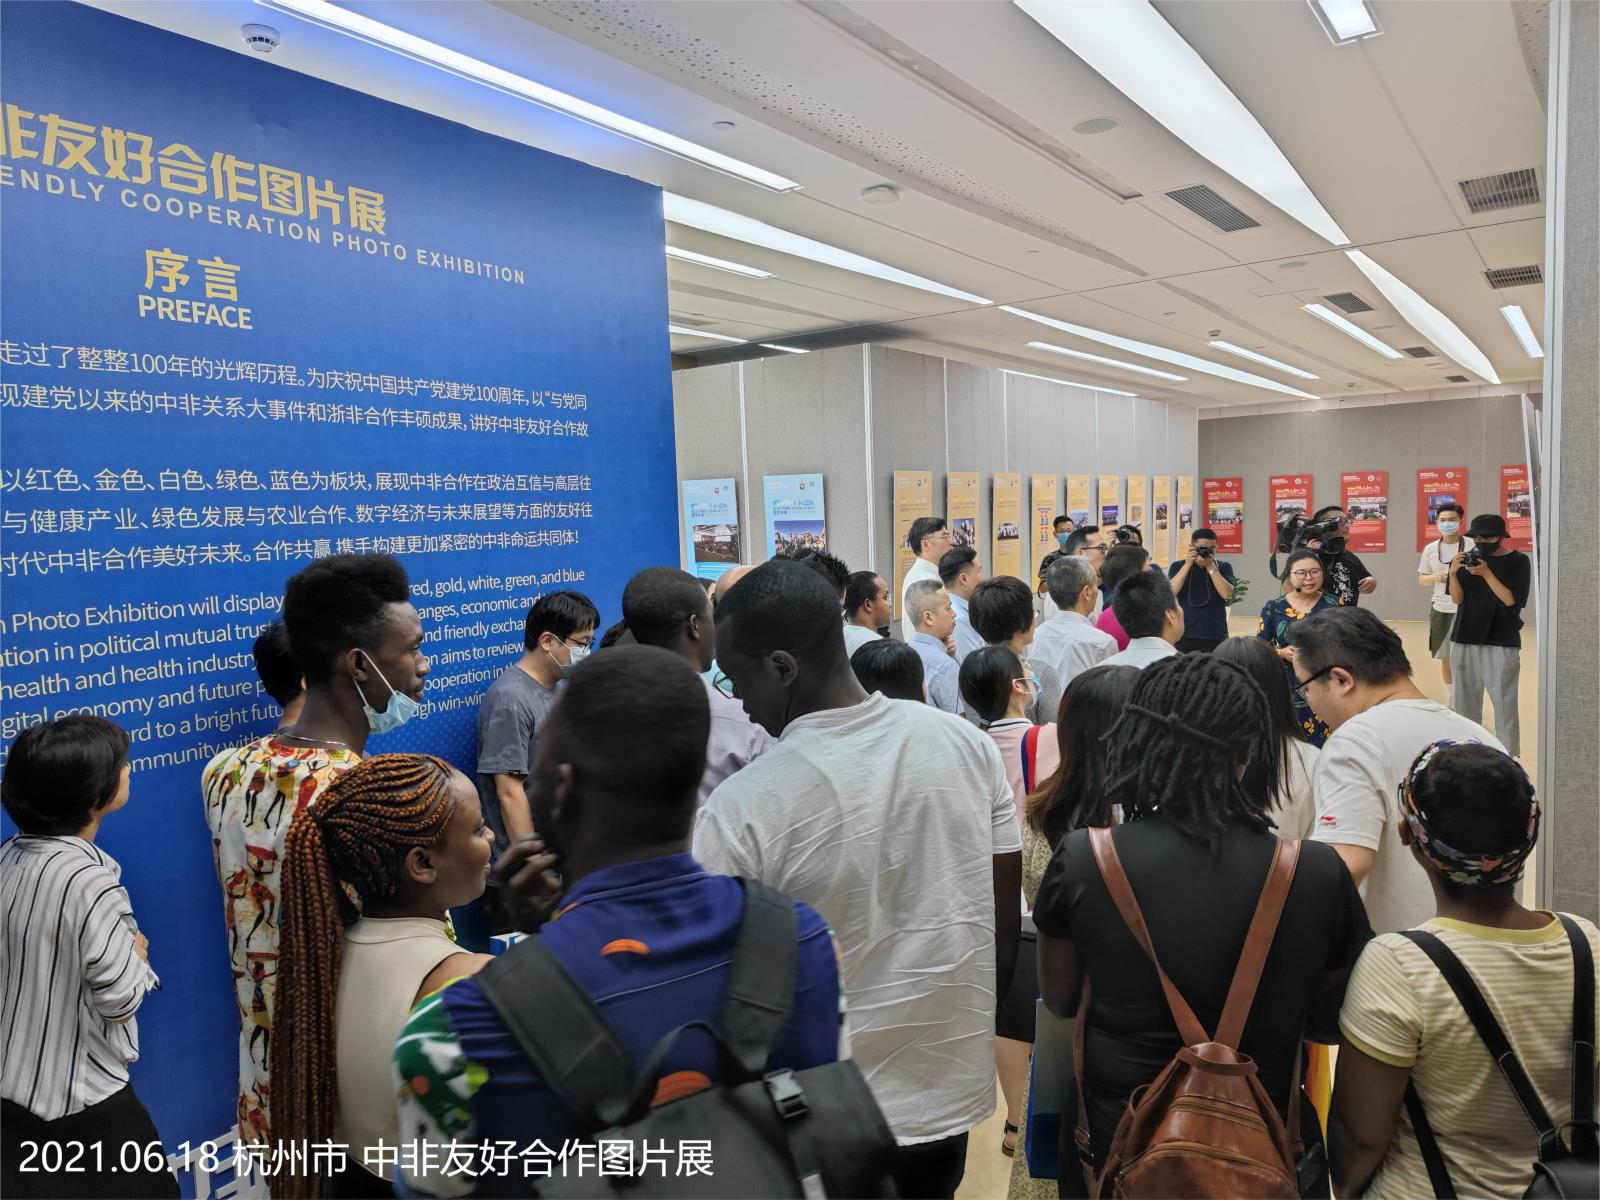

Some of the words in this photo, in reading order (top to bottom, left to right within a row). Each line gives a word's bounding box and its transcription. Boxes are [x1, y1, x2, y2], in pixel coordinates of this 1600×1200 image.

[120, 189, 321, 244] COOPERATION
[332, 231, 407, 261] PHOTO
[416, 249, 525, 284] EXHIBITION
[144, 247, 241, 301] 序言
[138, 294, 253, 330] PREFACE
[12, 611, 81, 633] Photo
[85, 601, 185, 627] Exhibition
[189, 596, 220, 616] will
[224, 592, 285, 615] display
[436, 577, 466, 598] gold,
[468, 575, 504, 591] white,
[505, 573, 540, 592] green,
[541, 570, 562, 584] and
[562, 568, 585, 582] blue
[54, 641, 74, 661] in
[79, 631, 160, 663] political
[165, 623, 231, 648] mutual
[461, 596, 519, 615] economic
[0, 673, 70, 700] health
[75, 667, 115, 690] and
[121, 658, 183, 684] health
[443, 621, 489, 640] friendly
[158, 685, 195, 710] and
[199, 680, 252, 703] future
[441, 648, 471, 664] aims
[472, 647, 485, 660] to
[487, 641, 525, 657] review
[155, 721, 176, 739] to
[180, 719, 192, 733] a
[195, 706, 248, 732] bright
[126, 742, 221, 773] ommunity
